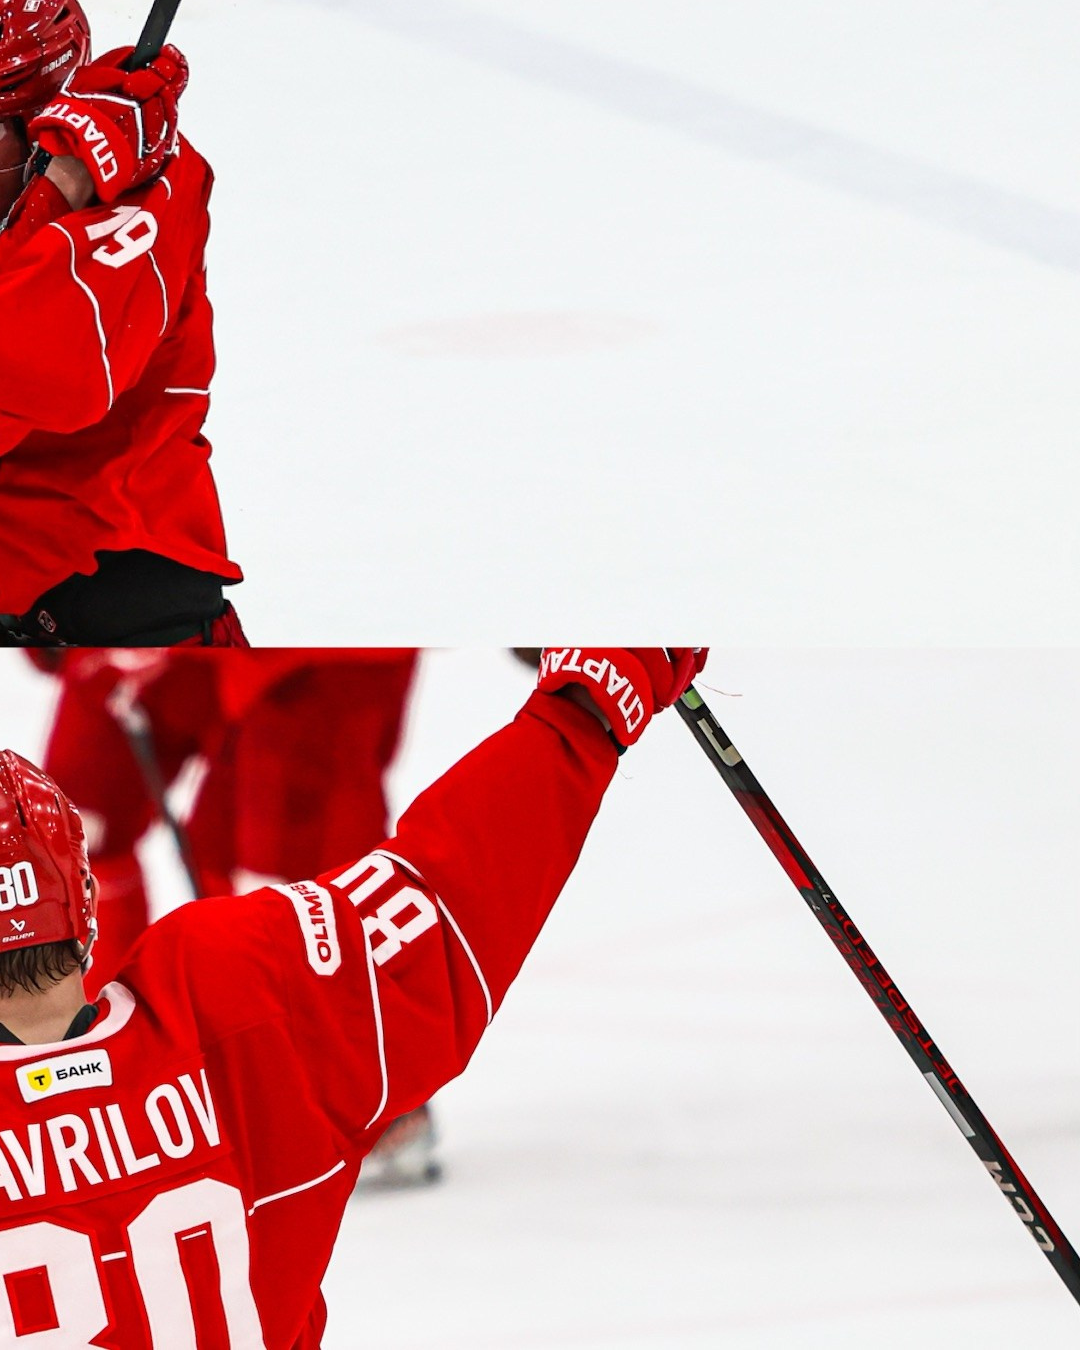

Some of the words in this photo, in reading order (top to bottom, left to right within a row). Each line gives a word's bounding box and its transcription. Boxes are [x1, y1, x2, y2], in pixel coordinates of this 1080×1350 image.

[85, 205, 159, 269] 19
[1, 930, 35, 943] BAUER
[329, 853, 439, 968] 80
[55, 1062, 104, 1081] БАНК
[983, 1160, 1055, 1252] CCM
